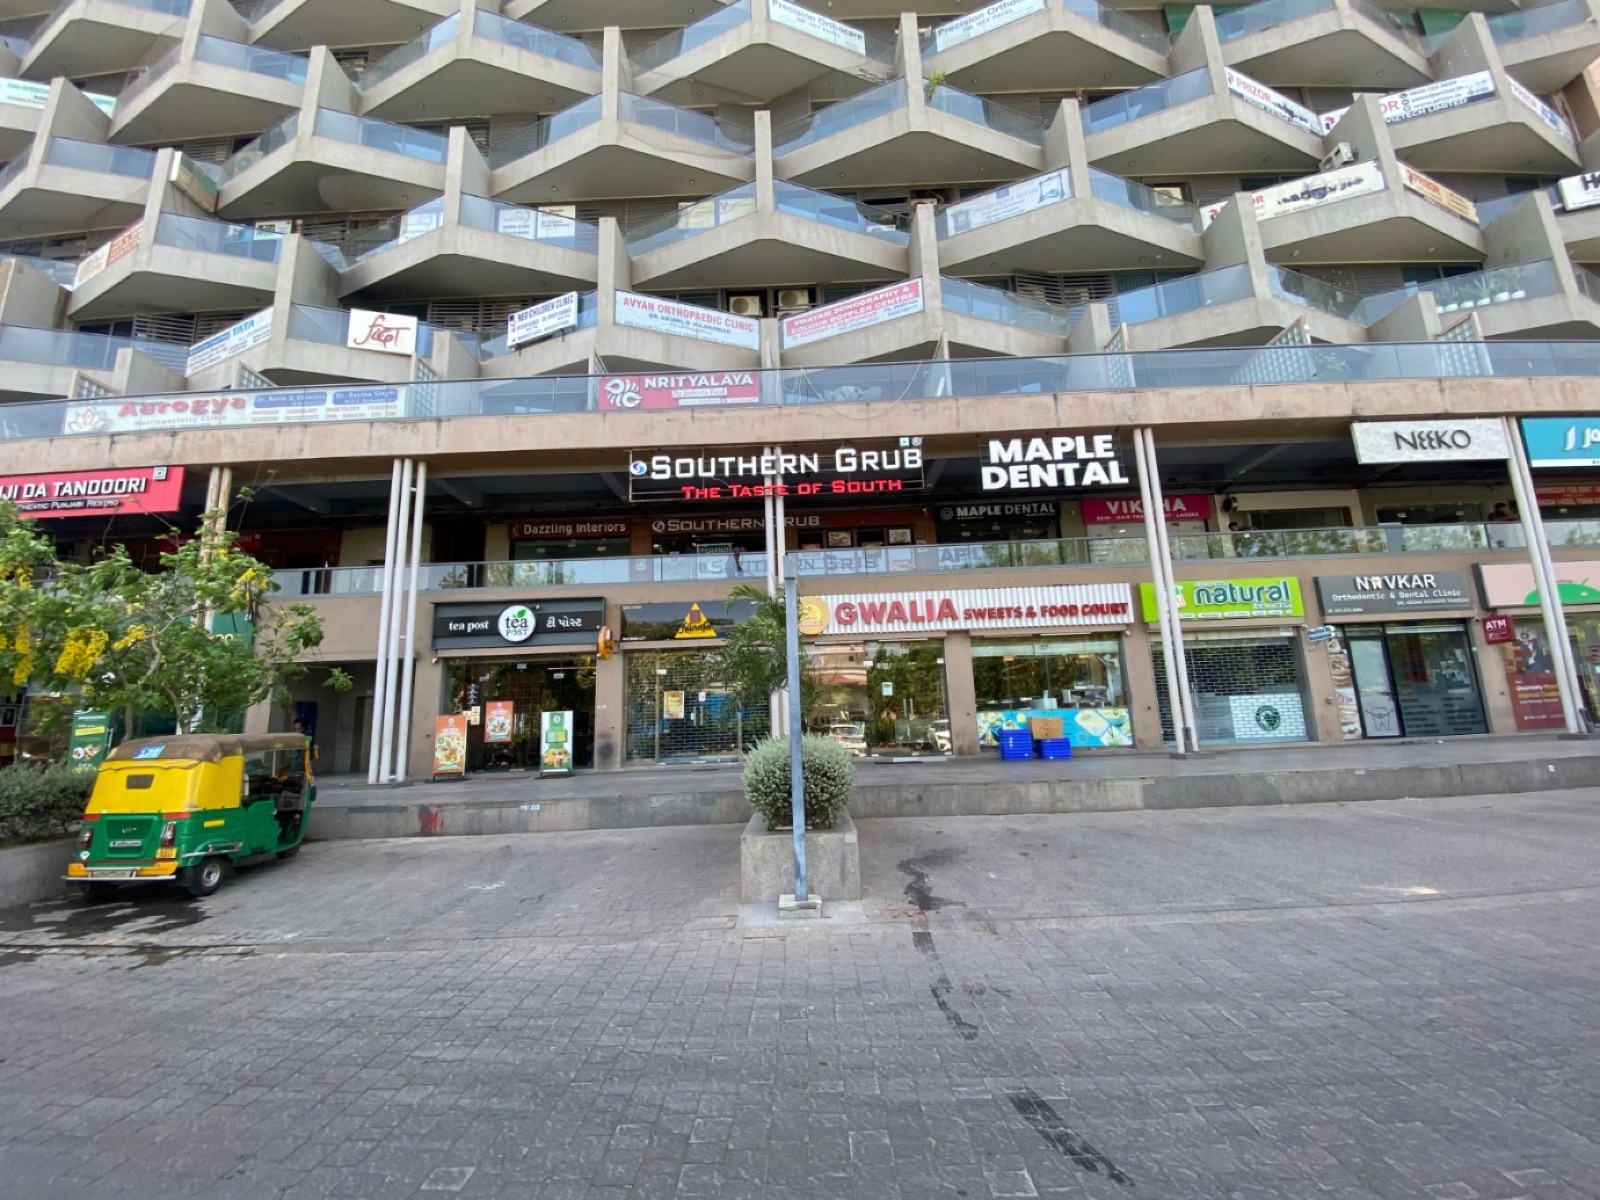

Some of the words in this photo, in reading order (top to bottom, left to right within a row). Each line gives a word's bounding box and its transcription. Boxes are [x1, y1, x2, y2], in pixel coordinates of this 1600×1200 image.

[938, 13, 984, 36] Precision
[1427, 98, 1467, 113] LIMITED
[830, 306, 873, 322] DOPPLER
[874, 292, 915, 309] CENTRE
[833, 289, 898, 315] SONOGRAPHY
[623, 297, 655, 311] AVYAN
[657, 304, 723, 325] ORTHOPAEDIC
[724, 318, 754, 332] CLINIC
[233, 319, 255, 336] TATA
[644, 373, 754, 389] NRITYALAYA
[117, 396, 247, 418] Aarogya
[988, 434, 1115, 464] MAPLE
[1393, 429, 1472, 451] NEEKO
[650, 452, 819, 480] SOUTHERN
[834, 448, 923, 473] GRUB
[981, 460, 1129, 490] DENTAL
[22, 482, 48, 499] DA
[53, 476, 148, 498] TANDOORI
[681, 484, 721, 499] THE
[728, 483, 789, 498] TASTE
[797, 482, 820, 494] OF
[831, 479, 903, 494] SOUTH
[956, 504, 1002, 517] MAPLE
[1004, 502, 1056, 515] DENTAL
[1106, 497, 1187, 515] VIKHA
[523, 523, 573, 536] Dazzling
[576, 522, 626, 533] Interiors
[667, 518, 765, 532] SOUTHERN
[776, 515, 820, 527] RUB
[1194, 579, 1291, 606] natural
[1331, 592, 1386, 602] Orthodontic
[1389, 591, 1396, 600] &
[1398, 590, 1429, 600] Dental
[1432, 588, 1462, 598] Clinic
[504, 614, 530, 629] tea
[834, 597, 961, 626] GWALIA
[963, 605, 1023, 621] SWEETS
[1026, 605, 1038, 619] &
[1040, 603, 1079, 619] FOOD
[1082, 602, 1129, 616] COURT
[448, 621, 466, 631] tea
[466, 619, 490, 633] post
[506, 628, 528, 636] POST
[1485, 618, 1507, 631] ATM
